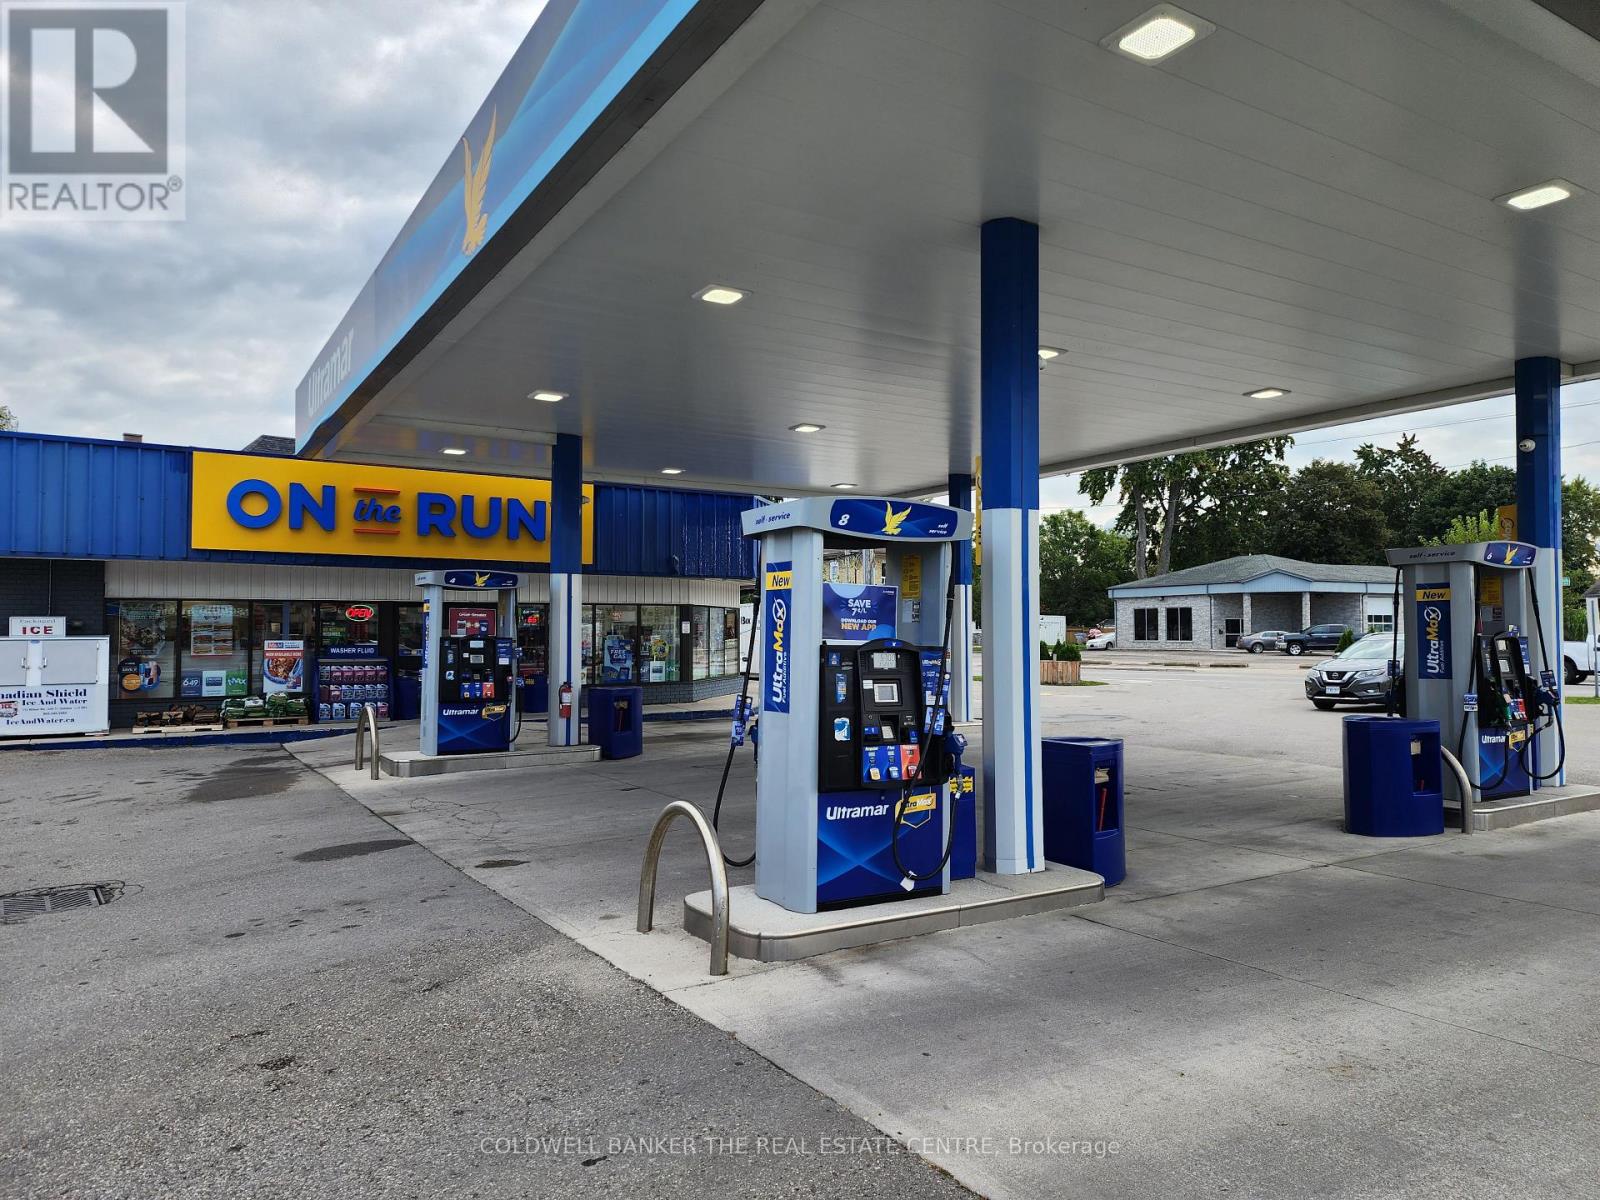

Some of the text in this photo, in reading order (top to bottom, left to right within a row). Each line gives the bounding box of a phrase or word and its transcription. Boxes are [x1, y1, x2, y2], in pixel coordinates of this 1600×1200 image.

[308, 327, 354, 417] Ultramar
[226, 478, 546, 542] ON the RUN
[838, 513, 850, 526] 8
[1486, 552, 1493, 560] 6
[771, 574, 791, 588] New
[1422, 591, 1446, 600] New
[848, 598, 871, 608] SAVE
[347, 607, 372, 618] OPEN
[22, 626, 54, 635] ICE
[840, 623, 859, 631] NEW
[1424, 608, 1441, 674] UltraMax
[772, 600, 786, 703] UltraMax
[46, 688, 87, 698] Shield
[443, 708, 479, 716] Ultramar
[6, 717, 75, 725] IceAndWater.ca
[826, 803, 889, 820] Ultramar
